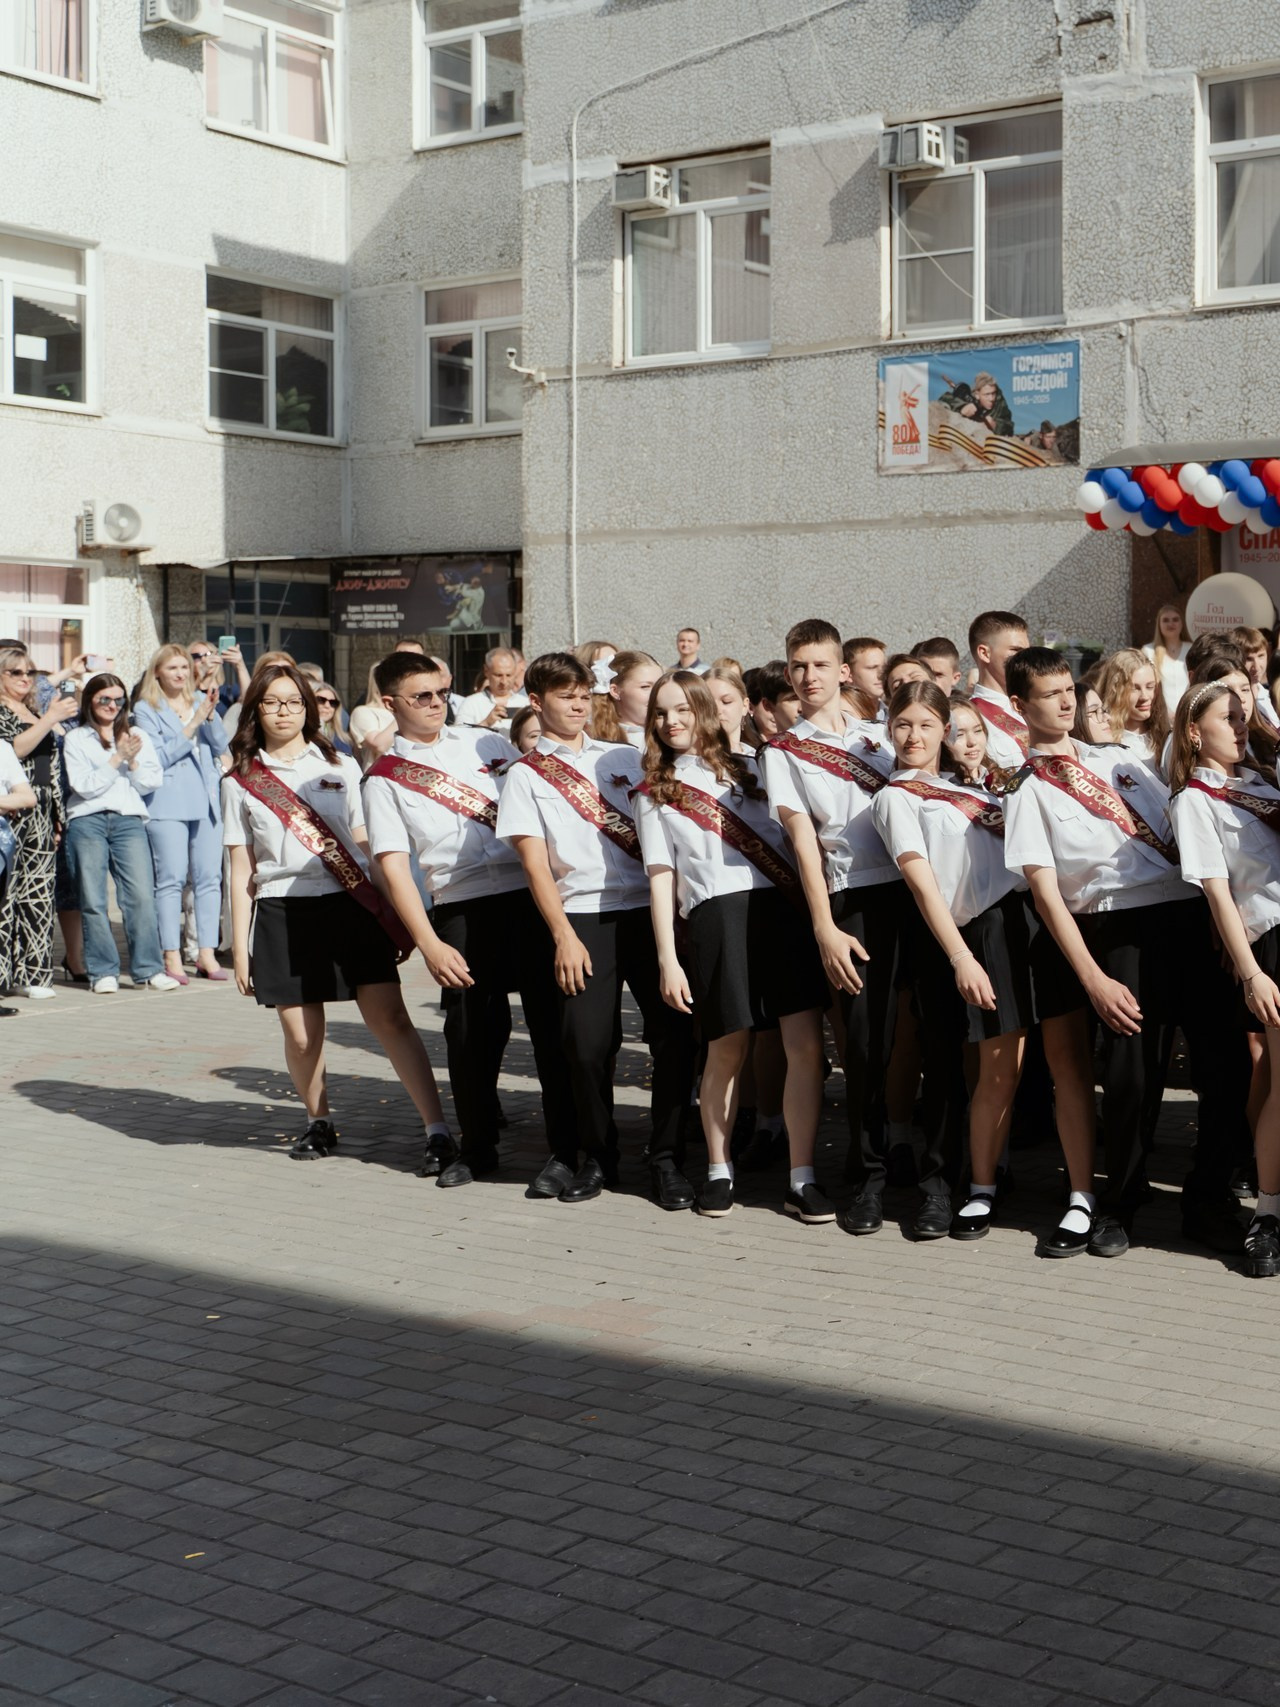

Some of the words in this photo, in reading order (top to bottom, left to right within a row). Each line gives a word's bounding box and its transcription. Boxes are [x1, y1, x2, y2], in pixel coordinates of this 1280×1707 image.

[1012, 351, 1074, 374] ГОРДИМСЯ
[1012, 370, 1069, 393] ПОБЕДОЙ!
[892, 424, 908, 443] 80
[1206, 602, 1225, 614] Год
